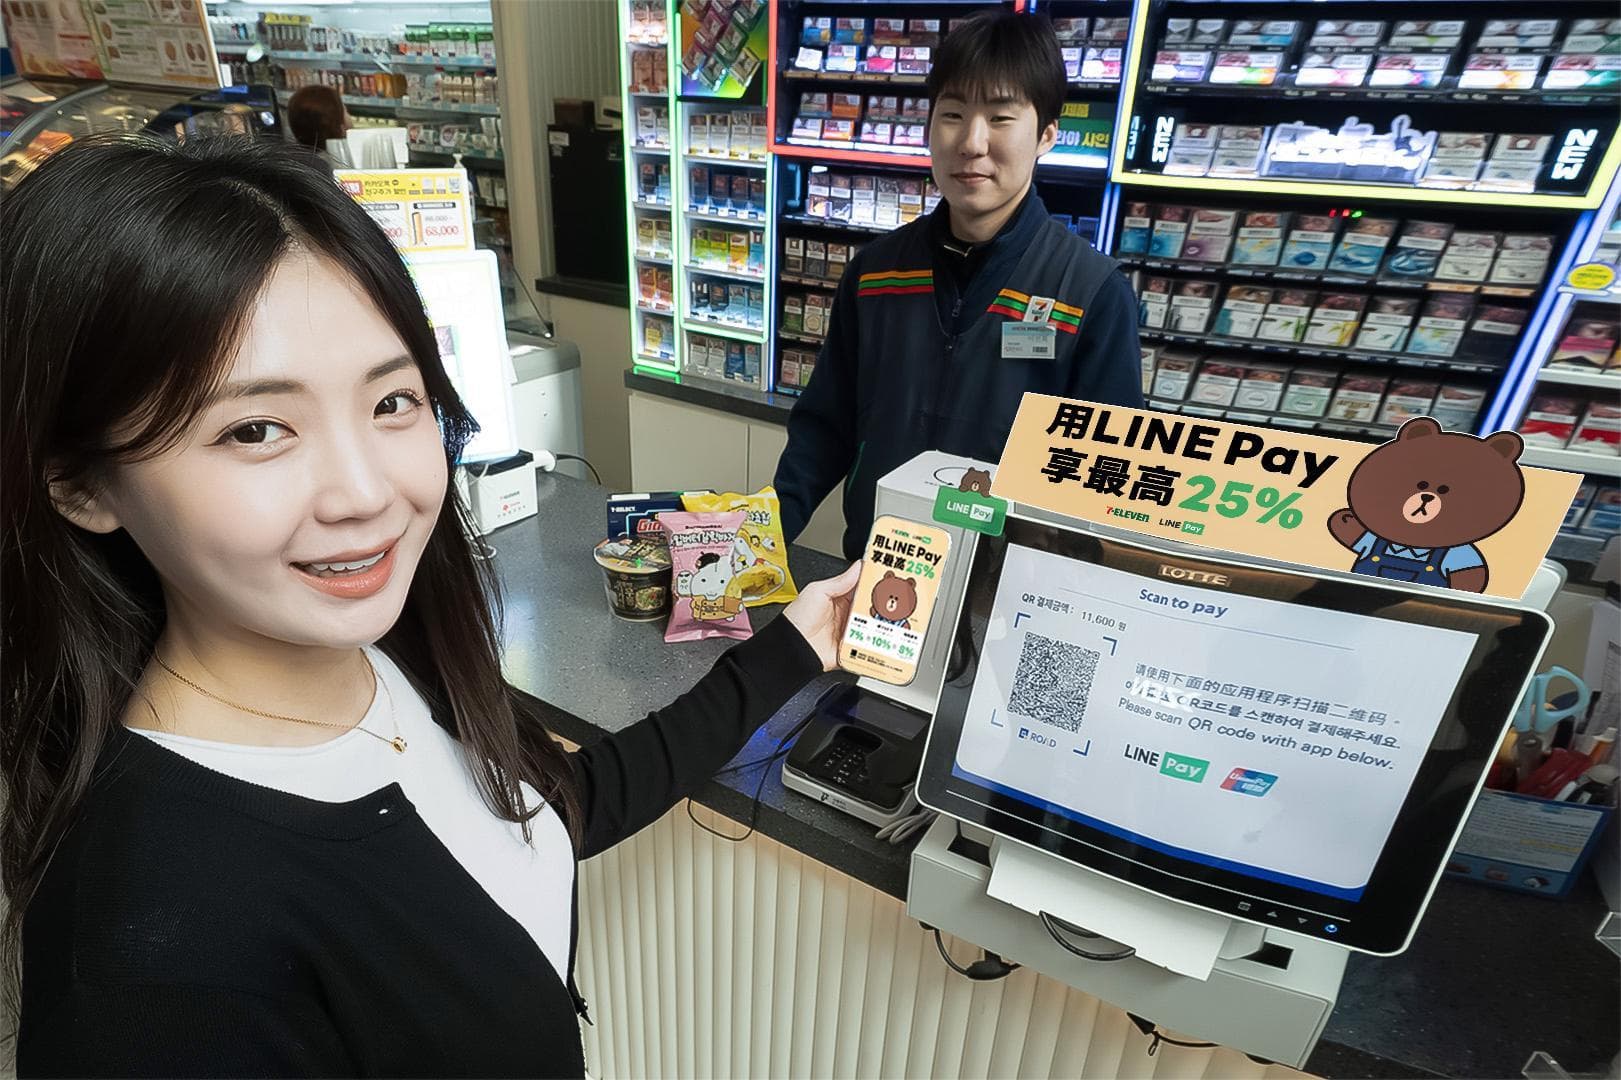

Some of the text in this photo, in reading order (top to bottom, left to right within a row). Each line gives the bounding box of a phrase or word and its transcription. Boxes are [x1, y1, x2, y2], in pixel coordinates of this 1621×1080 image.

[1152, 116, 1174, 162] NEW
[1552, 129, 1599, 178] NEW
[1046, 402, 1340, 489] 用LINE Pay
[1040, 446, 1304, 530] 享最高25%
[946, 501, 992, 519] LINE Pay
[1159, 518, 1202, 533] LINE Pay
[916, 547, 942, 566] Pay
[1162, 566, 1229, 586] LOTTE
[1021, 593, 1036, 605] QR
[1139, 588, 1229, 619] Scan to pay
[849, 629, 864, 641] 7%
[1118, 696, 1394, 771] Please scan QR code with app below.
[1124, 743, 1202, 778] LINE Pay
